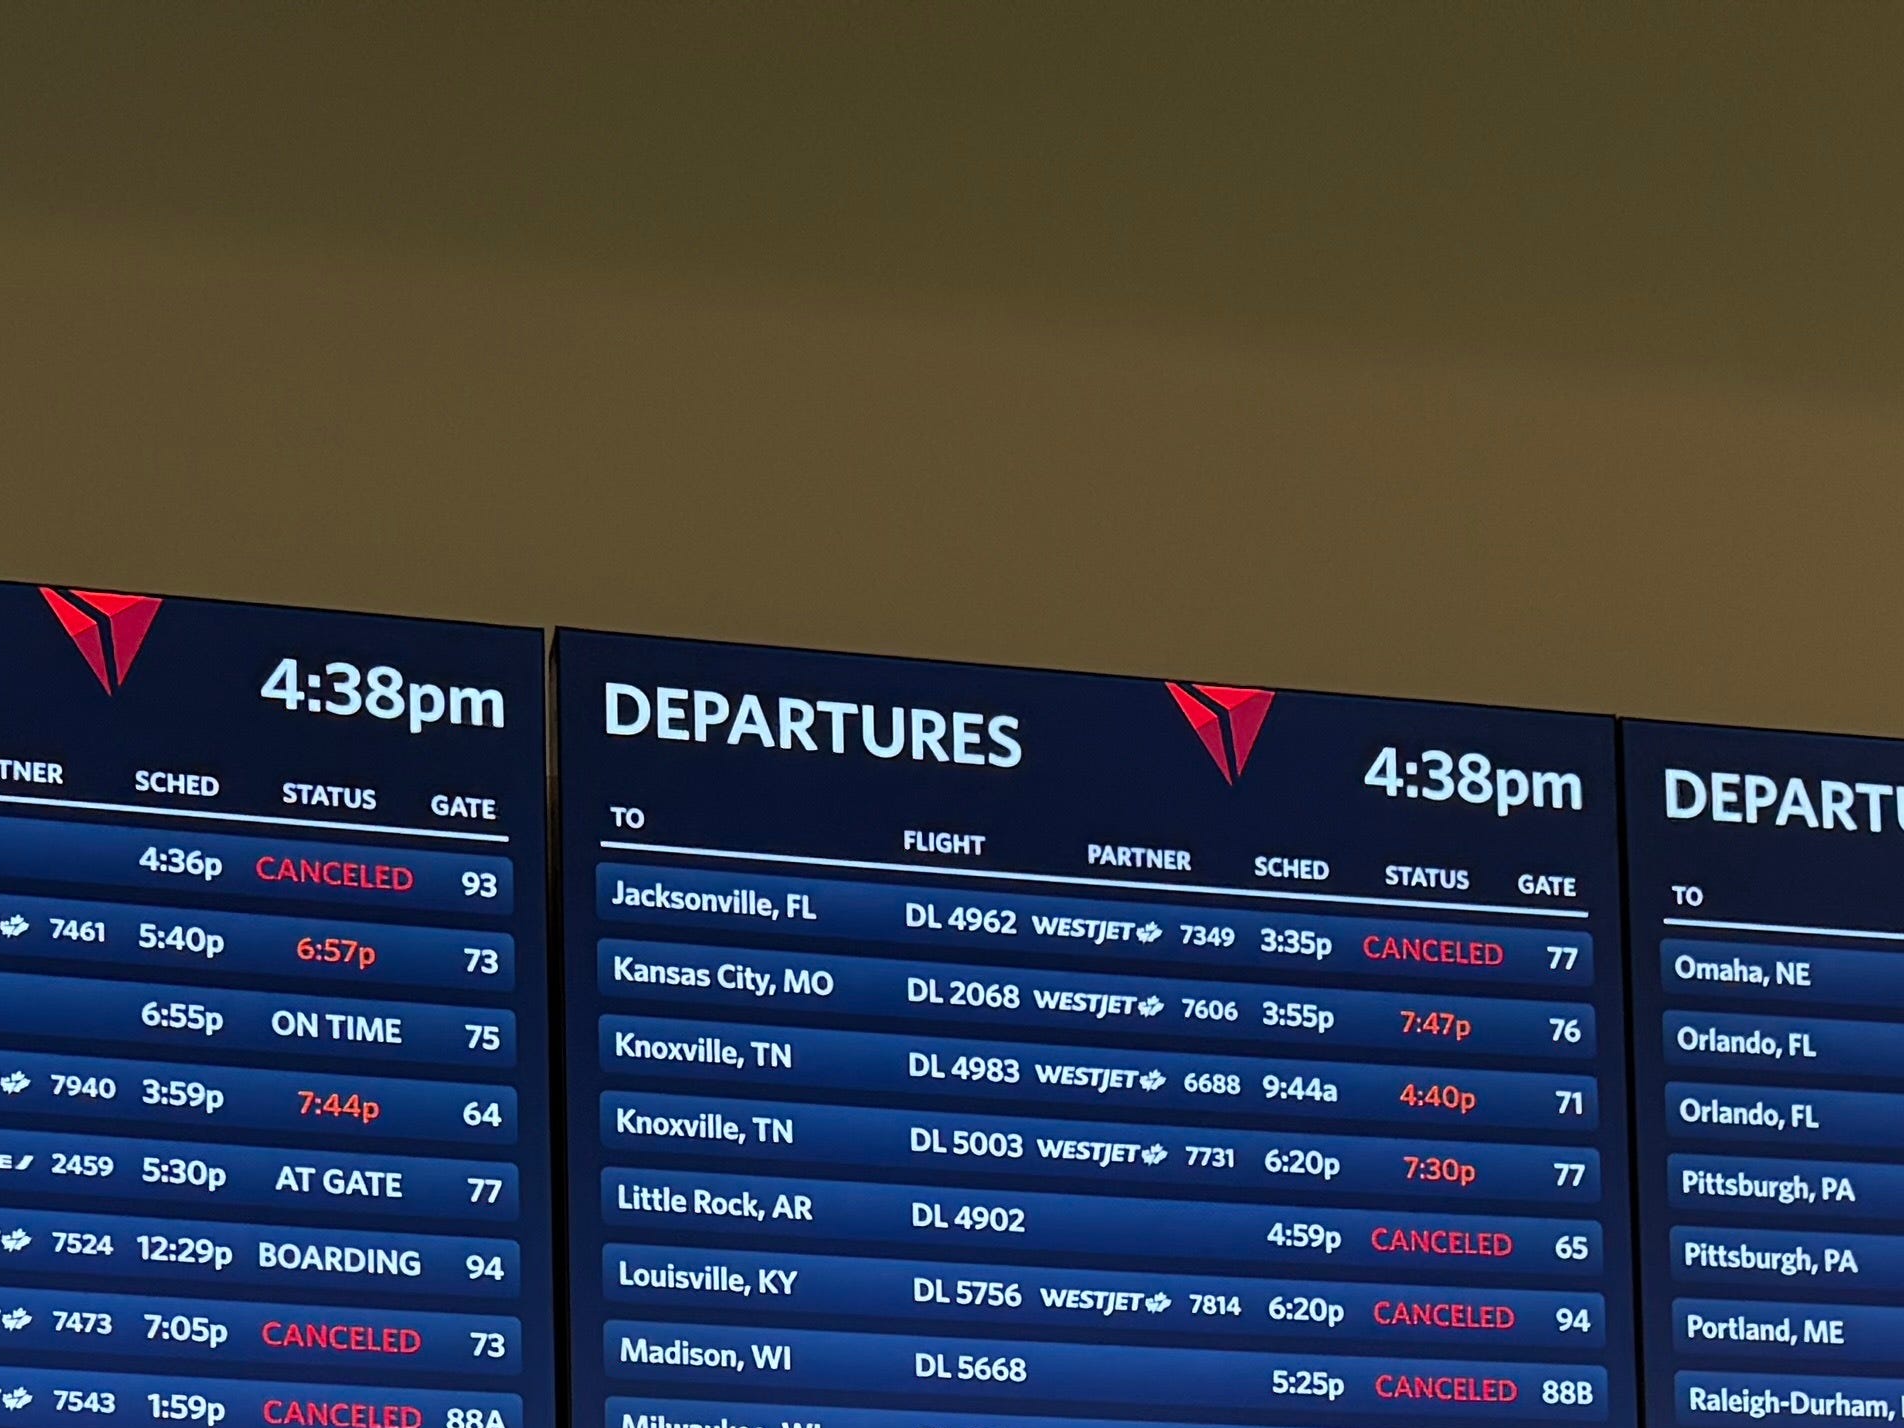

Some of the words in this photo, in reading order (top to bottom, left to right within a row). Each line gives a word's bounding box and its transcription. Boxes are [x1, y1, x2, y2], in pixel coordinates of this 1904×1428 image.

[261, 659, 504, 733] 4:38pm
[606, 682, 1021, 767] DEPARTURES
[136, 771, 219, 796] SCHED
[283, 783, 376, 809] STATUS
[431, 795, 496, 819] GATE
[612, 880, 779, 920] Jacksonville,
[787, 894, 816, 919] FL
[906, 903, 942, 928] DL
[948, 907, 1017, 934] 4962
[1032, 916, 1135, 944] WESTJET
[1180, 925, 1235, 947] 7349
[1261, 928, 1332, 960] 3:35p
[1363, 936, 1503, 965] CANCELED
[1547, 946, 1578, 970] 77
[51, 1075, 116, 1098] 7940
[143, 1079, 224, 1113] 3:59p
[298, 1091, 380, 1124] 7:44p
[463, 1102, 502, 1126] 64
